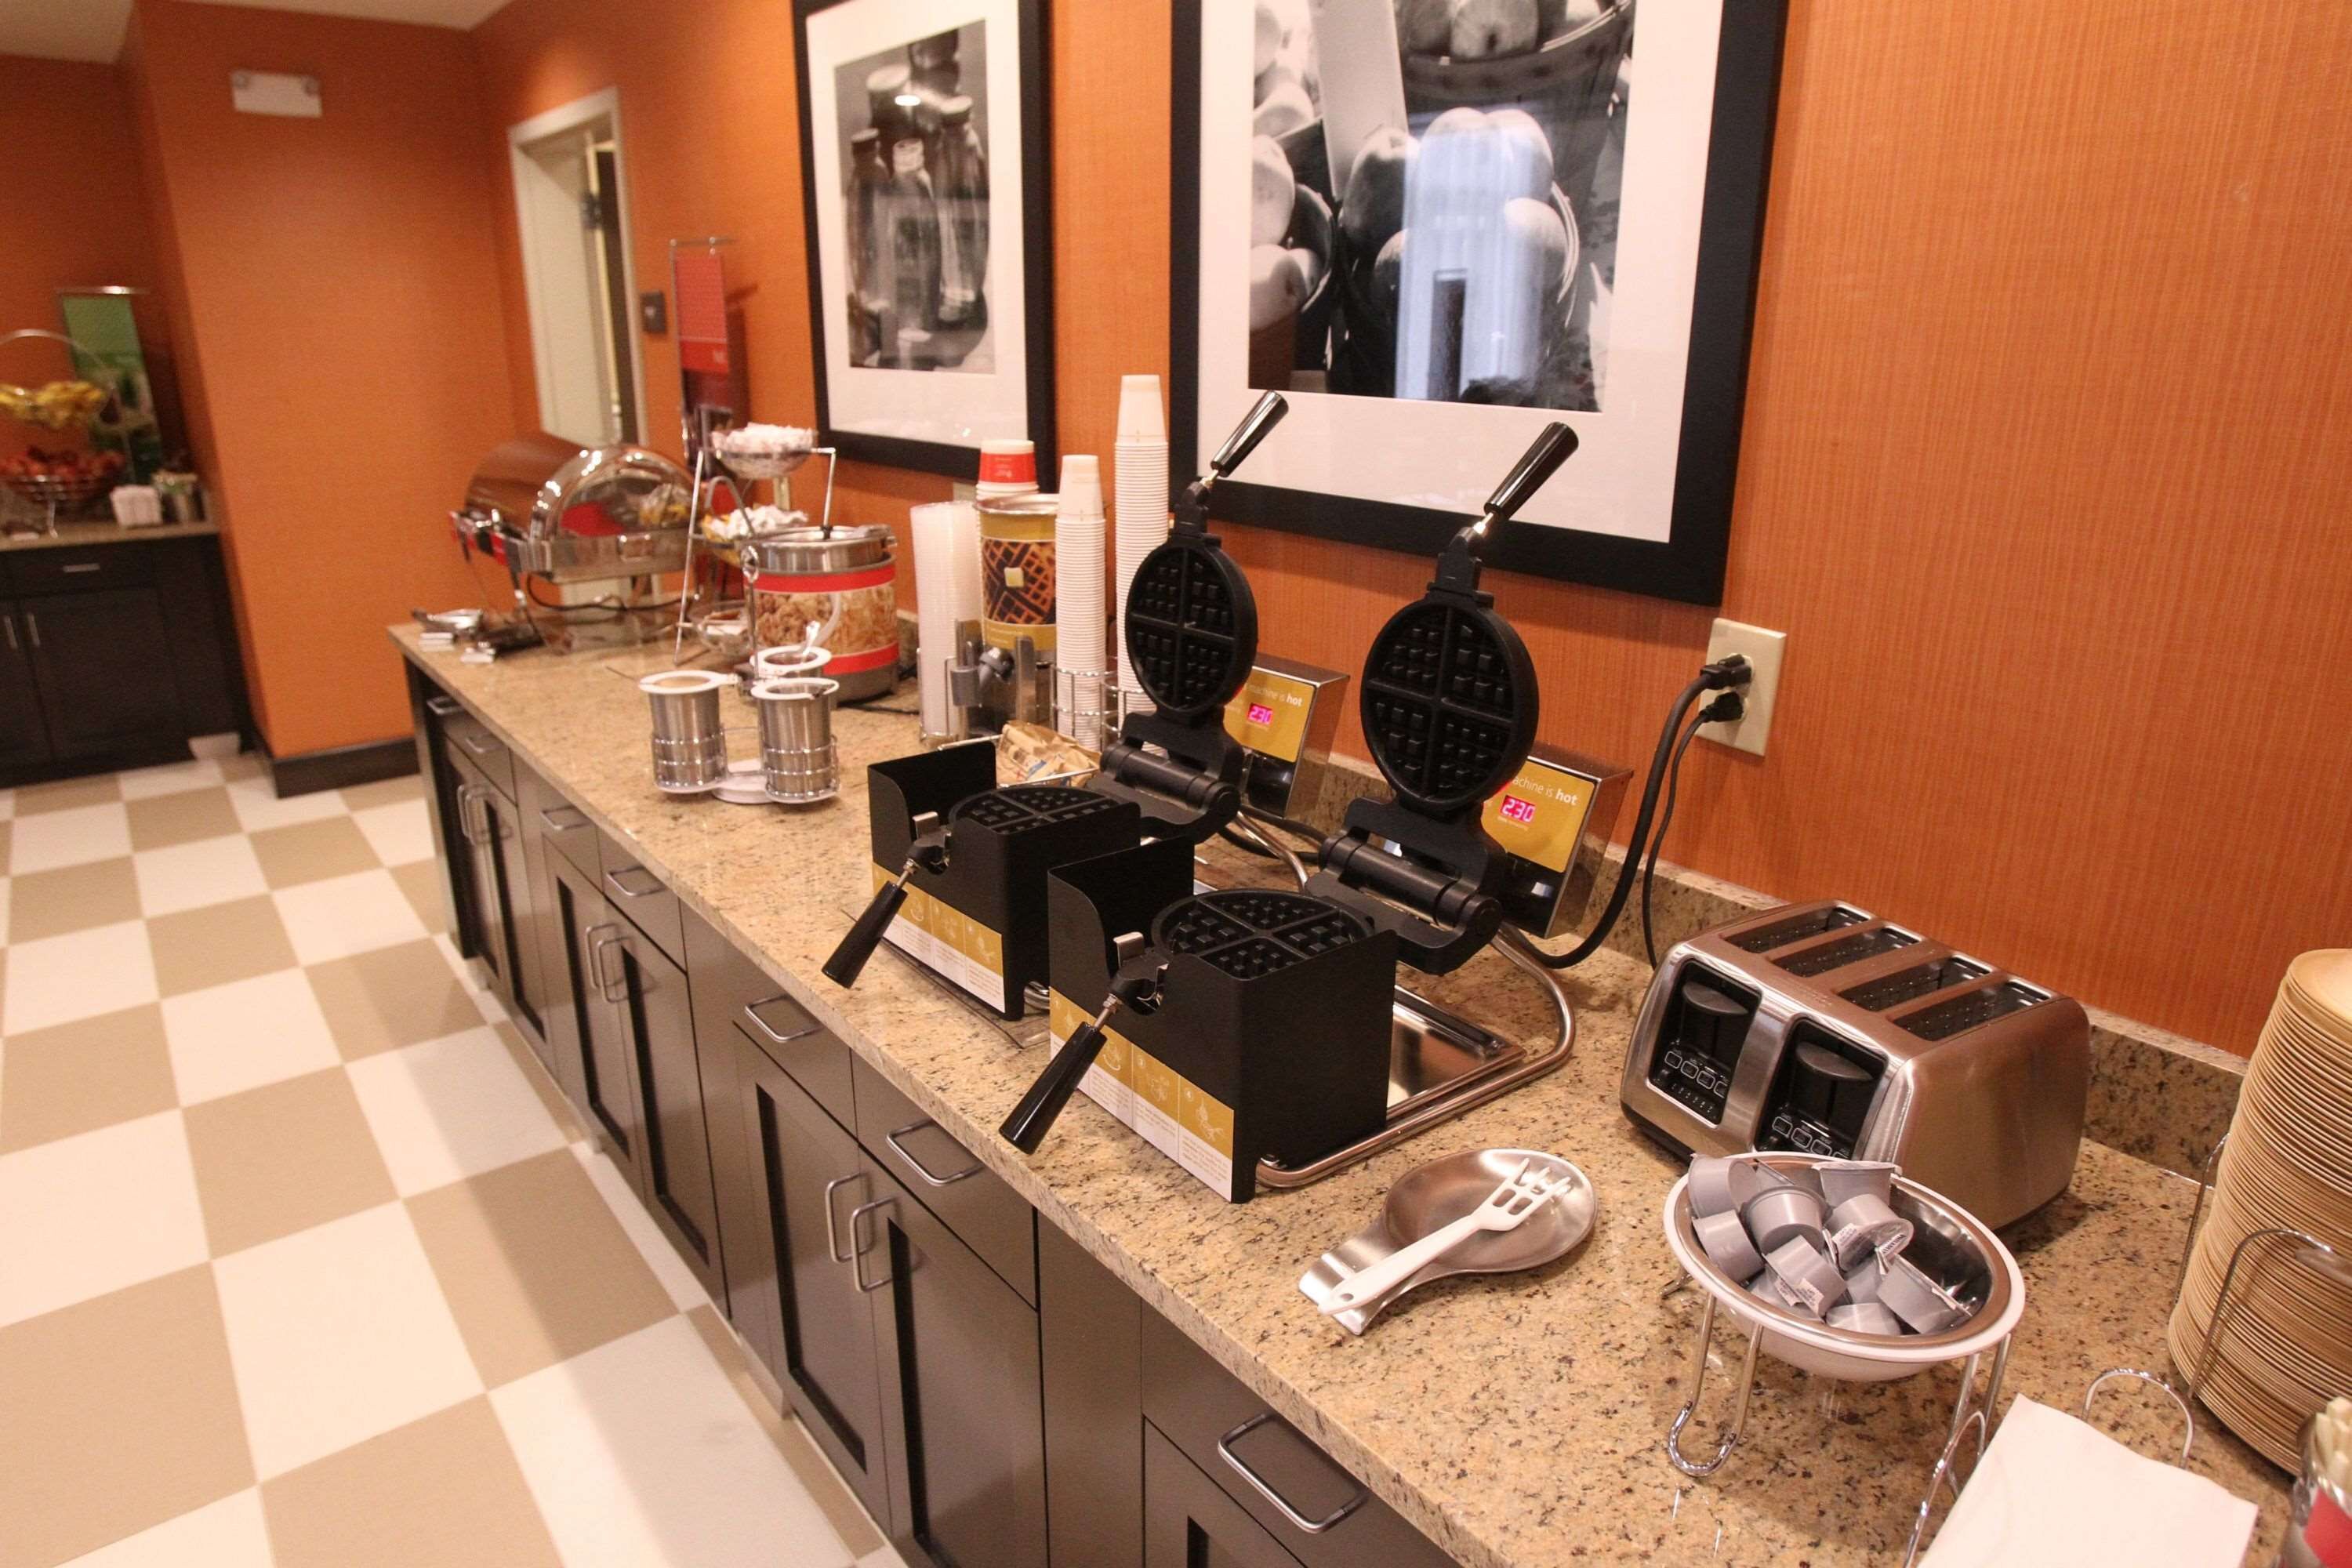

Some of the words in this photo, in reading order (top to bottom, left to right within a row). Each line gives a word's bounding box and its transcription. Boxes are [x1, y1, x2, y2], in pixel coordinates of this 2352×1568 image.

[1287, 693, 1303, 707] hot
[1512, 775, 1544, 793] achine
[1545, 784, 1554, 797] is
[1555, 788, 1578, 805] hot
